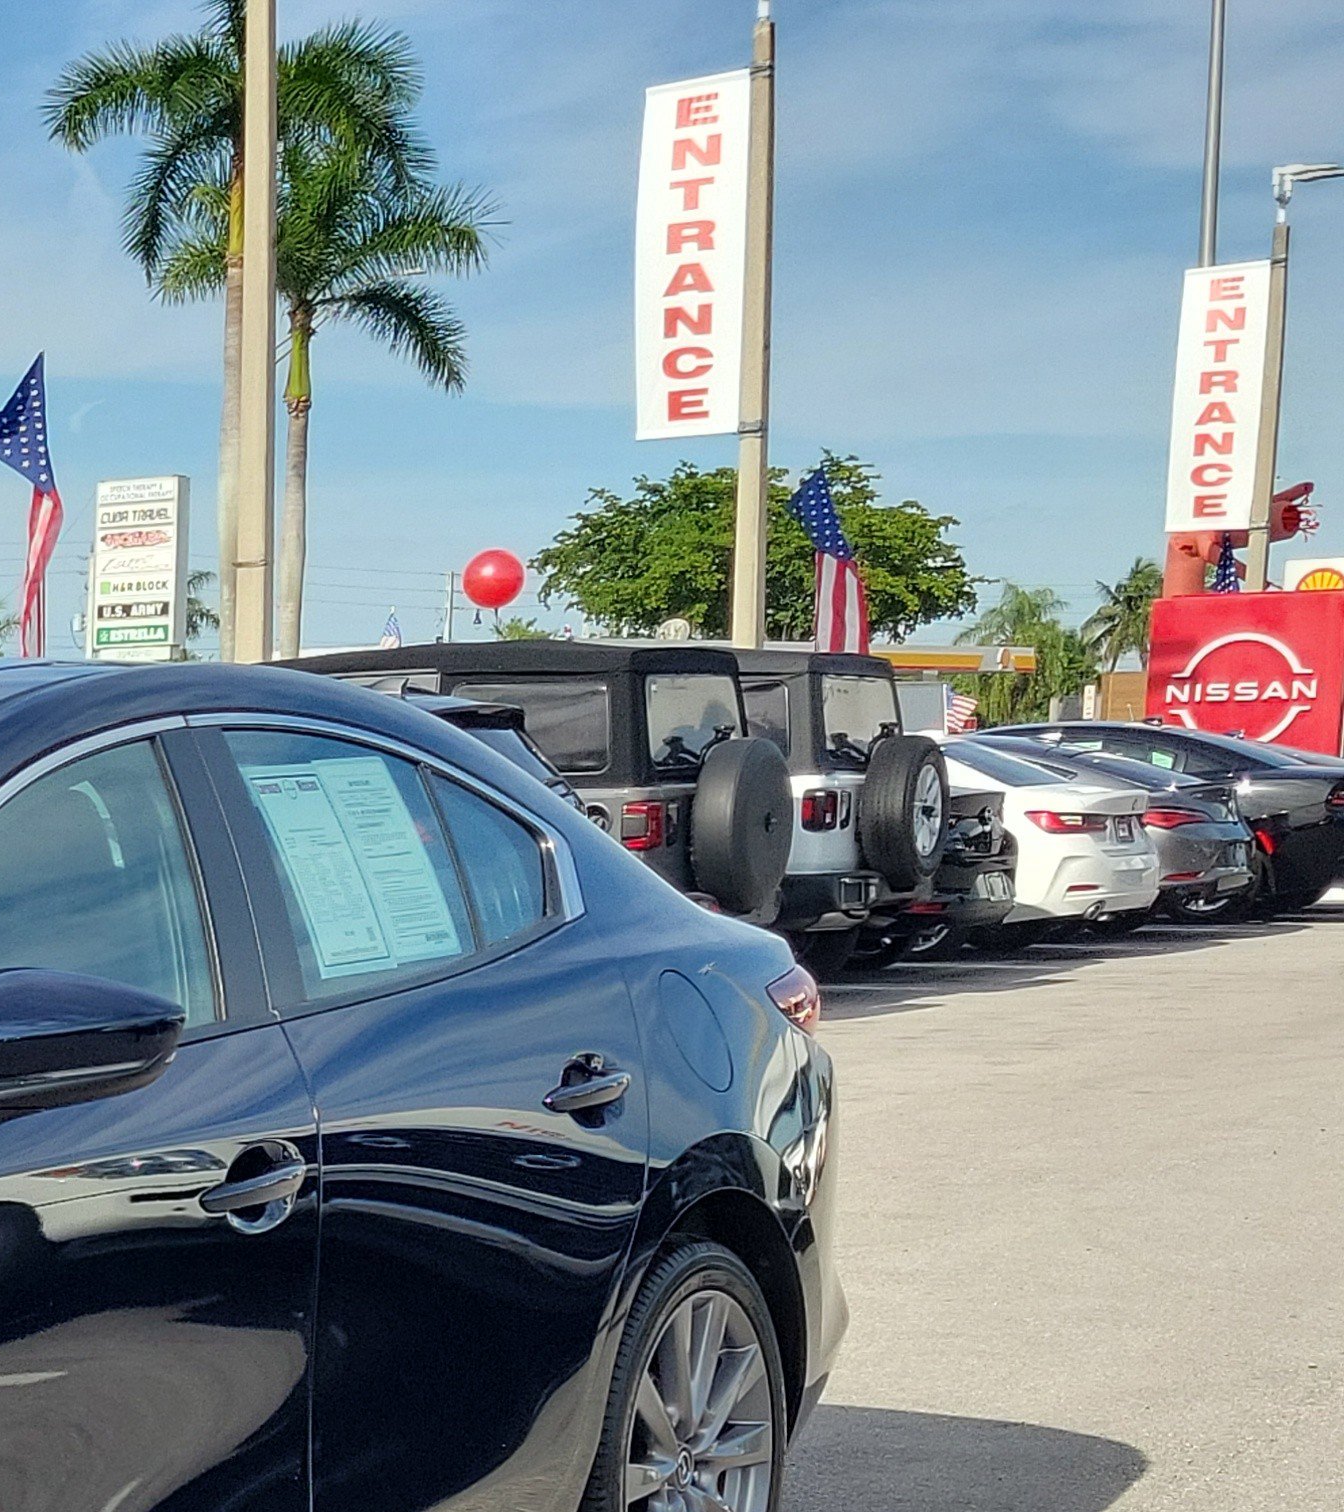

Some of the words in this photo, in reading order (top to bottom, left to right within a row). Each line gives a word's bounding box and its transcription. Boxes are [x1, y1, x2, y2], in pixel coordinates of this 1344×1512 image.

[662, 92, 723, 422] ENTRANCE
[1190, 276, 1246, 519] ENTRANCE
[100, 510, 129, 524] CUBA
[132, 507, 172, 522] TRAVEL
[112, 582, 133, 592] H&R
[136, 580, 169, 591] BLOCK
[102, 605, 127, 618] U.S.
[130, 602, 164, 617] ARMY
[109, 627, 165, 642] ESTRELLA
[1165, 679, 1318, 704] NISSAN
